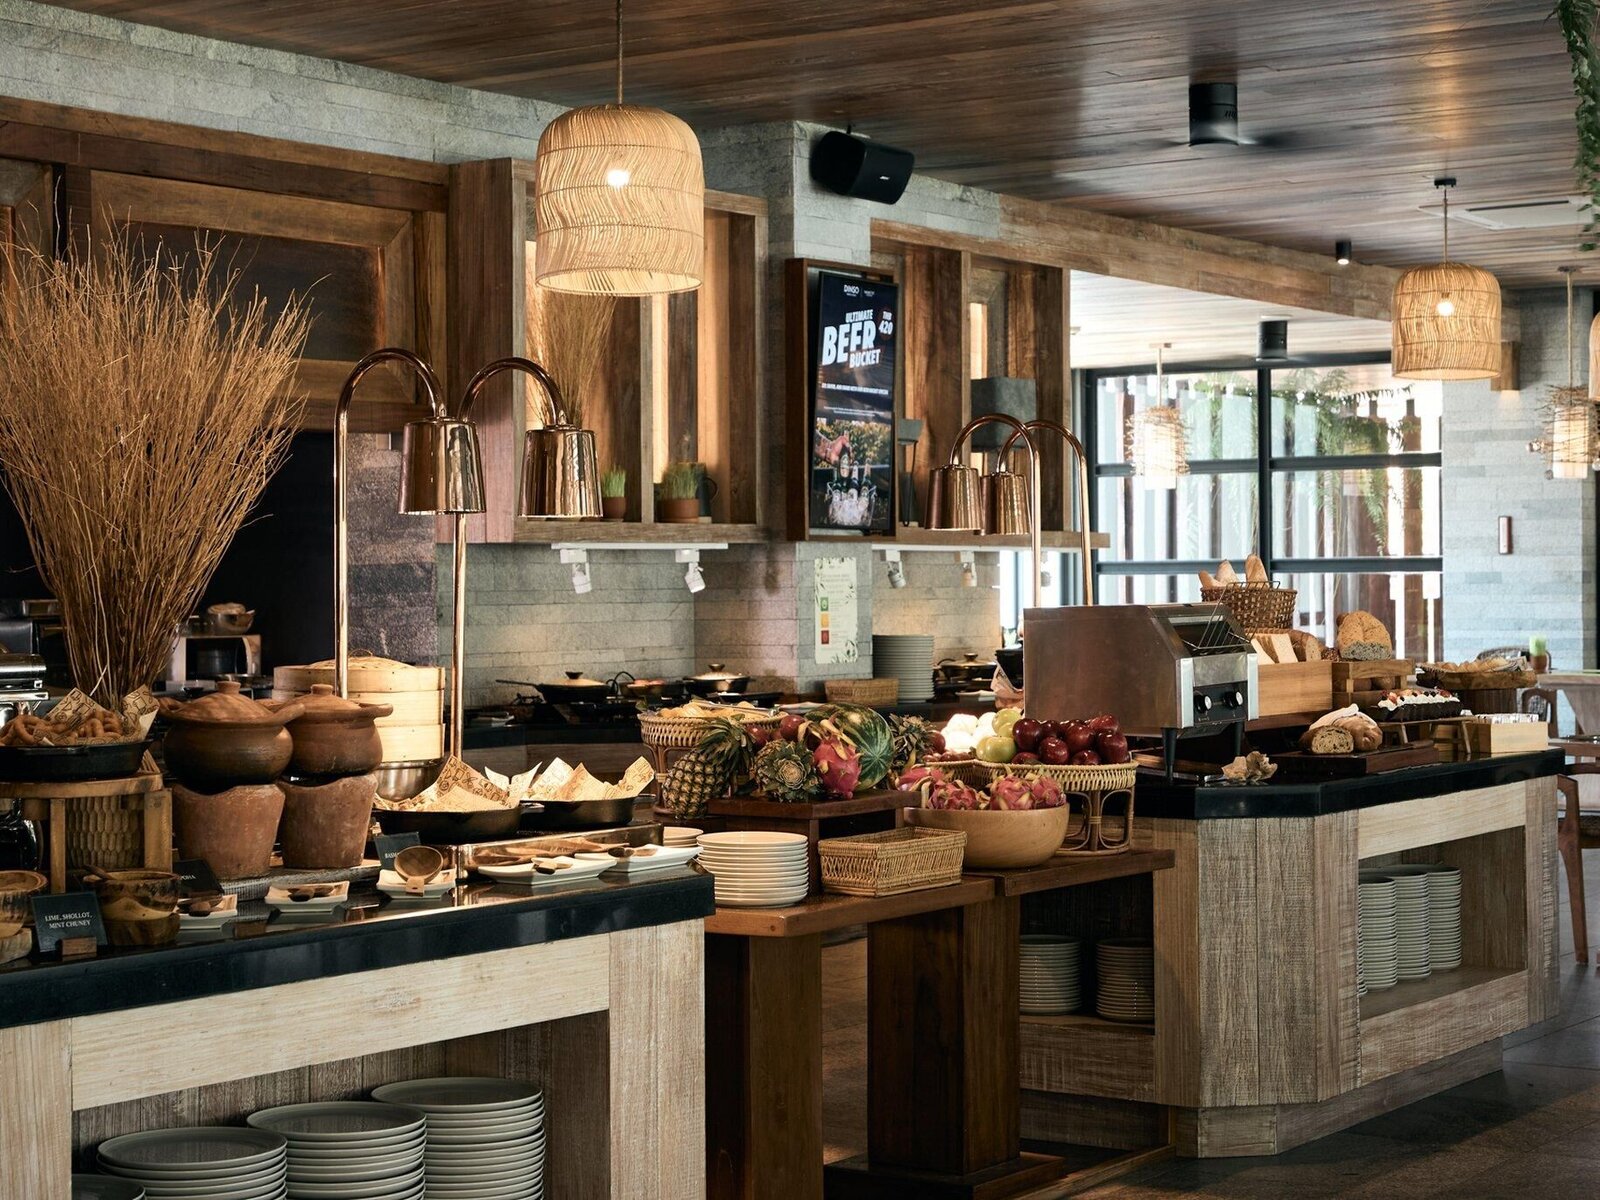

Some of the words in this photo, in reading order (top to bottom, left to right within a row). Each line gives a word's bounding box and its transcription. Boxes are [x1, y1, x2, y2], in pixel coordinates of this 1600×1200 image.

[846, 309, 874, 323] ULTIMATE
[879, 320, 893, 335] 420
[822, 320, 876, 366] BEER
[849, 349, 881, 368] BUCKET
